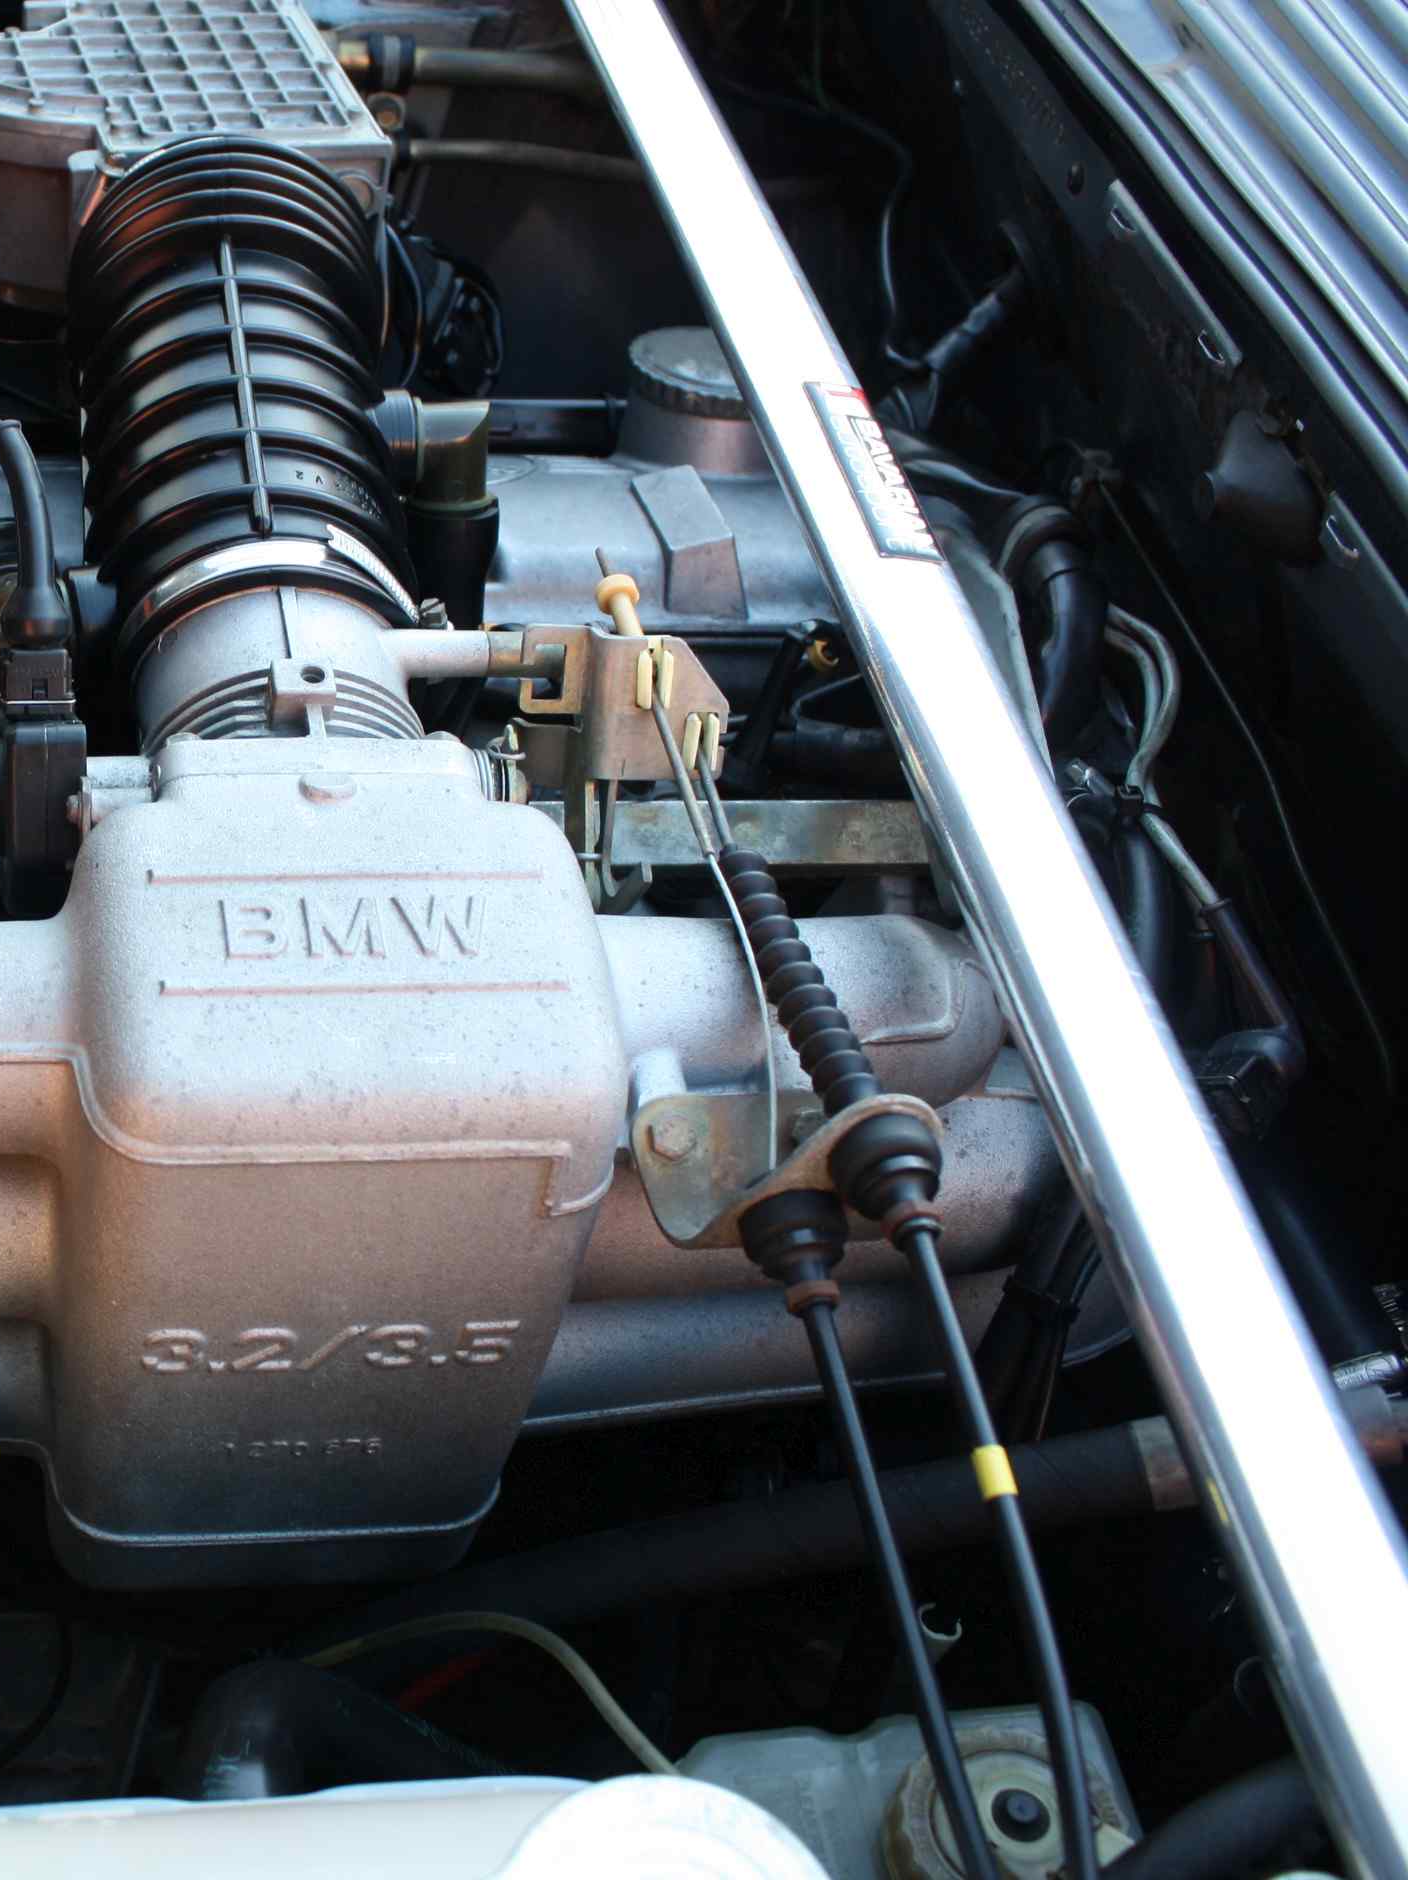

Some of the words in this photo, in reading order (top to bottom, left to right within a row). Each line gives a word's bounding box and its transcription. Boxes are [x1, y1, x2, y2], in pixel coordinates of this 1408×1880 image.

[853, 418, 941, 556] BAVARIAN
[218, 896, 487, 959] BMW
[142, 1319, 521, 1372] 3.2/3.5
